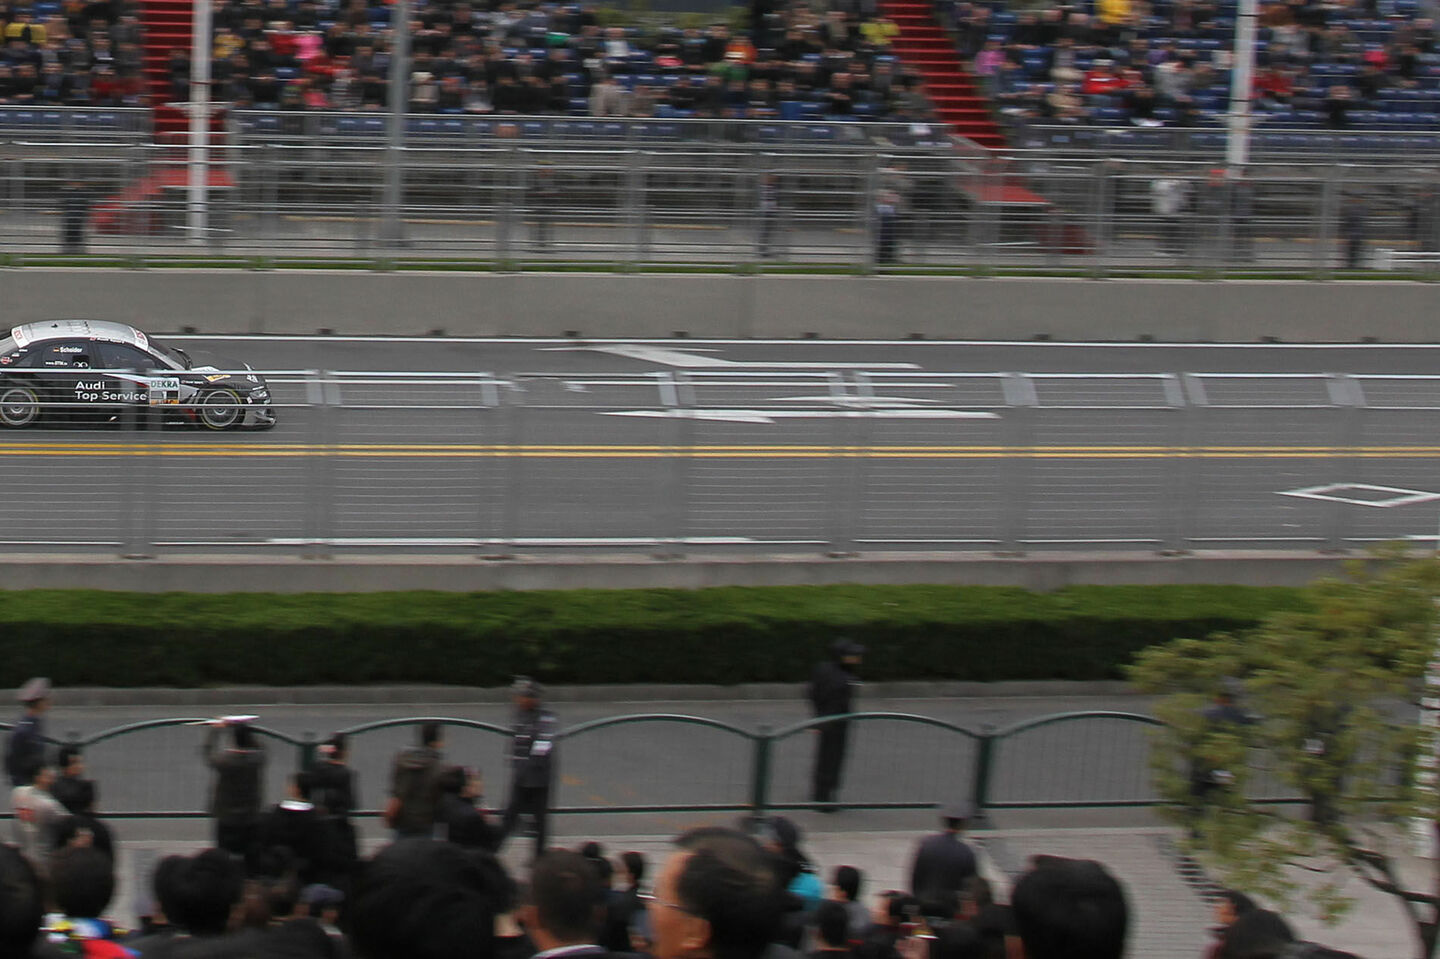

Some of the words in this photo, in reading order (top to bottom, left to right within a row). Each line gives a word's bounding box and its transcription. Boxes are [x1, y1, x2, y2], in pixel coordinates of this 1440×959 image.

[75, 381, 106, 391] Audi
[151, 380, 179, 388] DEKRA
[75, 390, 99, 402] Top
[101, 391, 148, 401] Service
